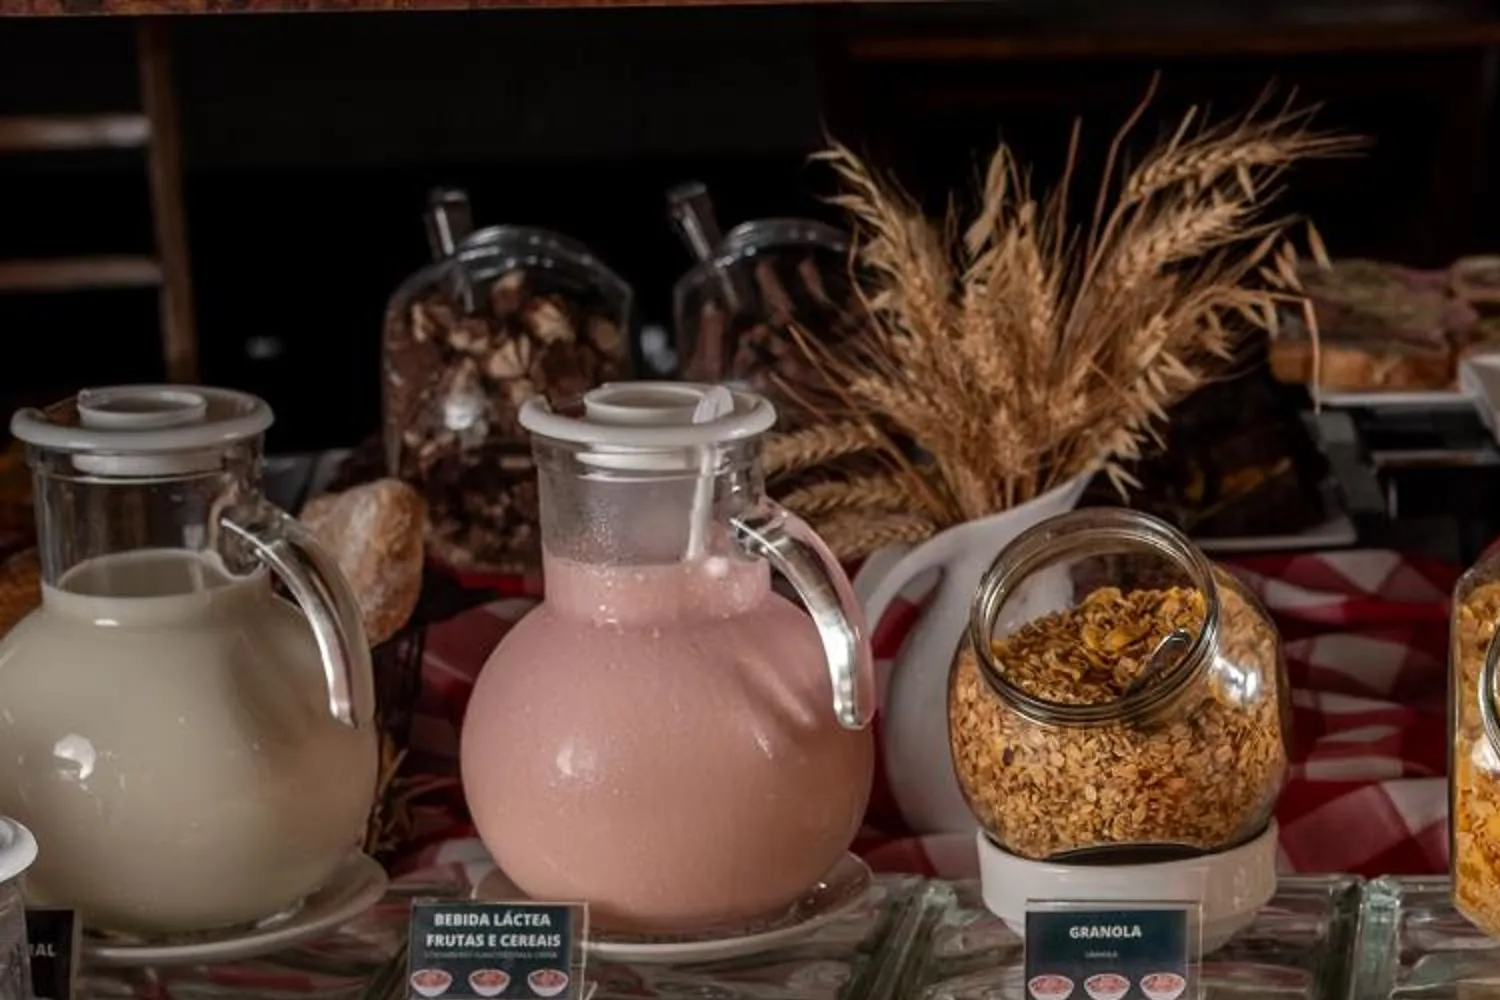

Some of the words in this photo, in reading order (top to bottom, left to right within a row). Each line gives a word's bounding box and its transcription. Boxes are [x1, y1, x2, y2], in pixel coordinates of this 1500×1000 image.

[434, 913, 491, 927] BEBIDA
[493, 910, 551, 927] LÁCTEA
[1069, 925, 1142, 939] GRANOLA
[426, 933, 485, 947] FRUTAS
[488, 934, 497, 947] E
[500, 934, 561, 947] CEREAIS
